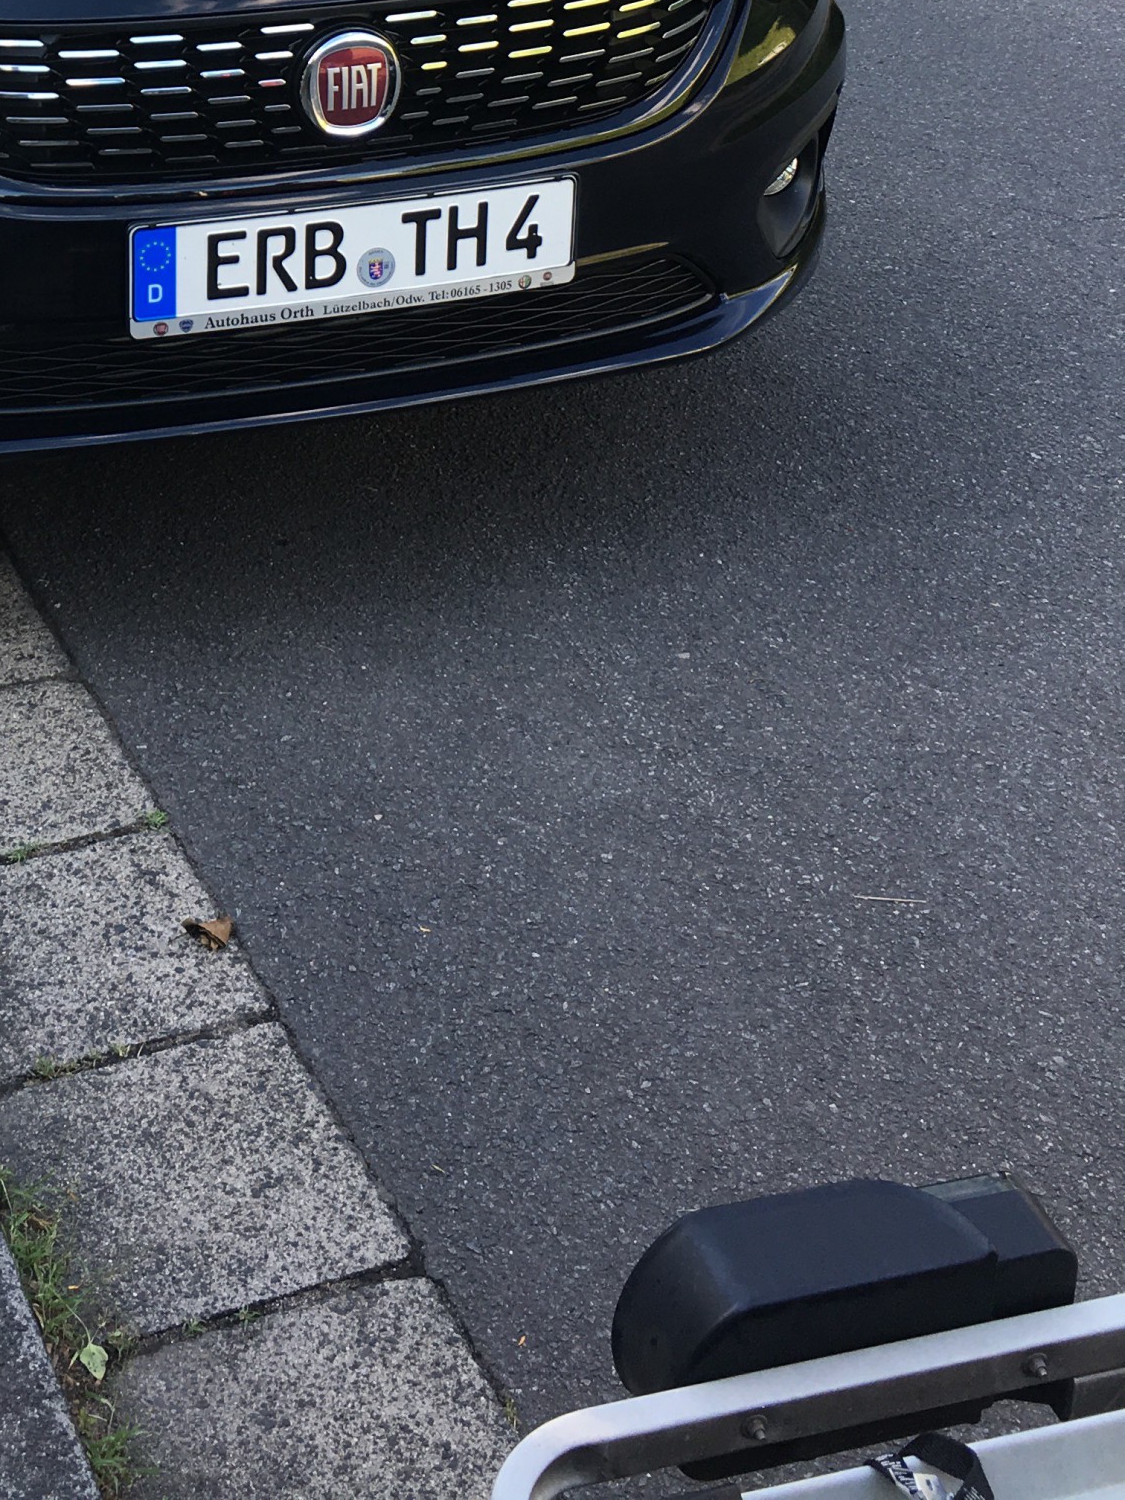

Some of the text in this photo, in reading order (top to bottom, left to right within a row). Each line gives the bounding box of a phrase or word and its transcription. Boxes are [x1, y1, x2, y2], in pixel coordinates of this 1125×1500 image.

[327, 62, 382, 112] FIAT
[207, 220, 347, 300] ERB
[401, 200, 488, 276] TH
[505, 194, 543, 259] 4
[148, 284, 163, 303] D
[204, 311, 276, 330] Autohaus
[280, 305, 315, 320] Orth
